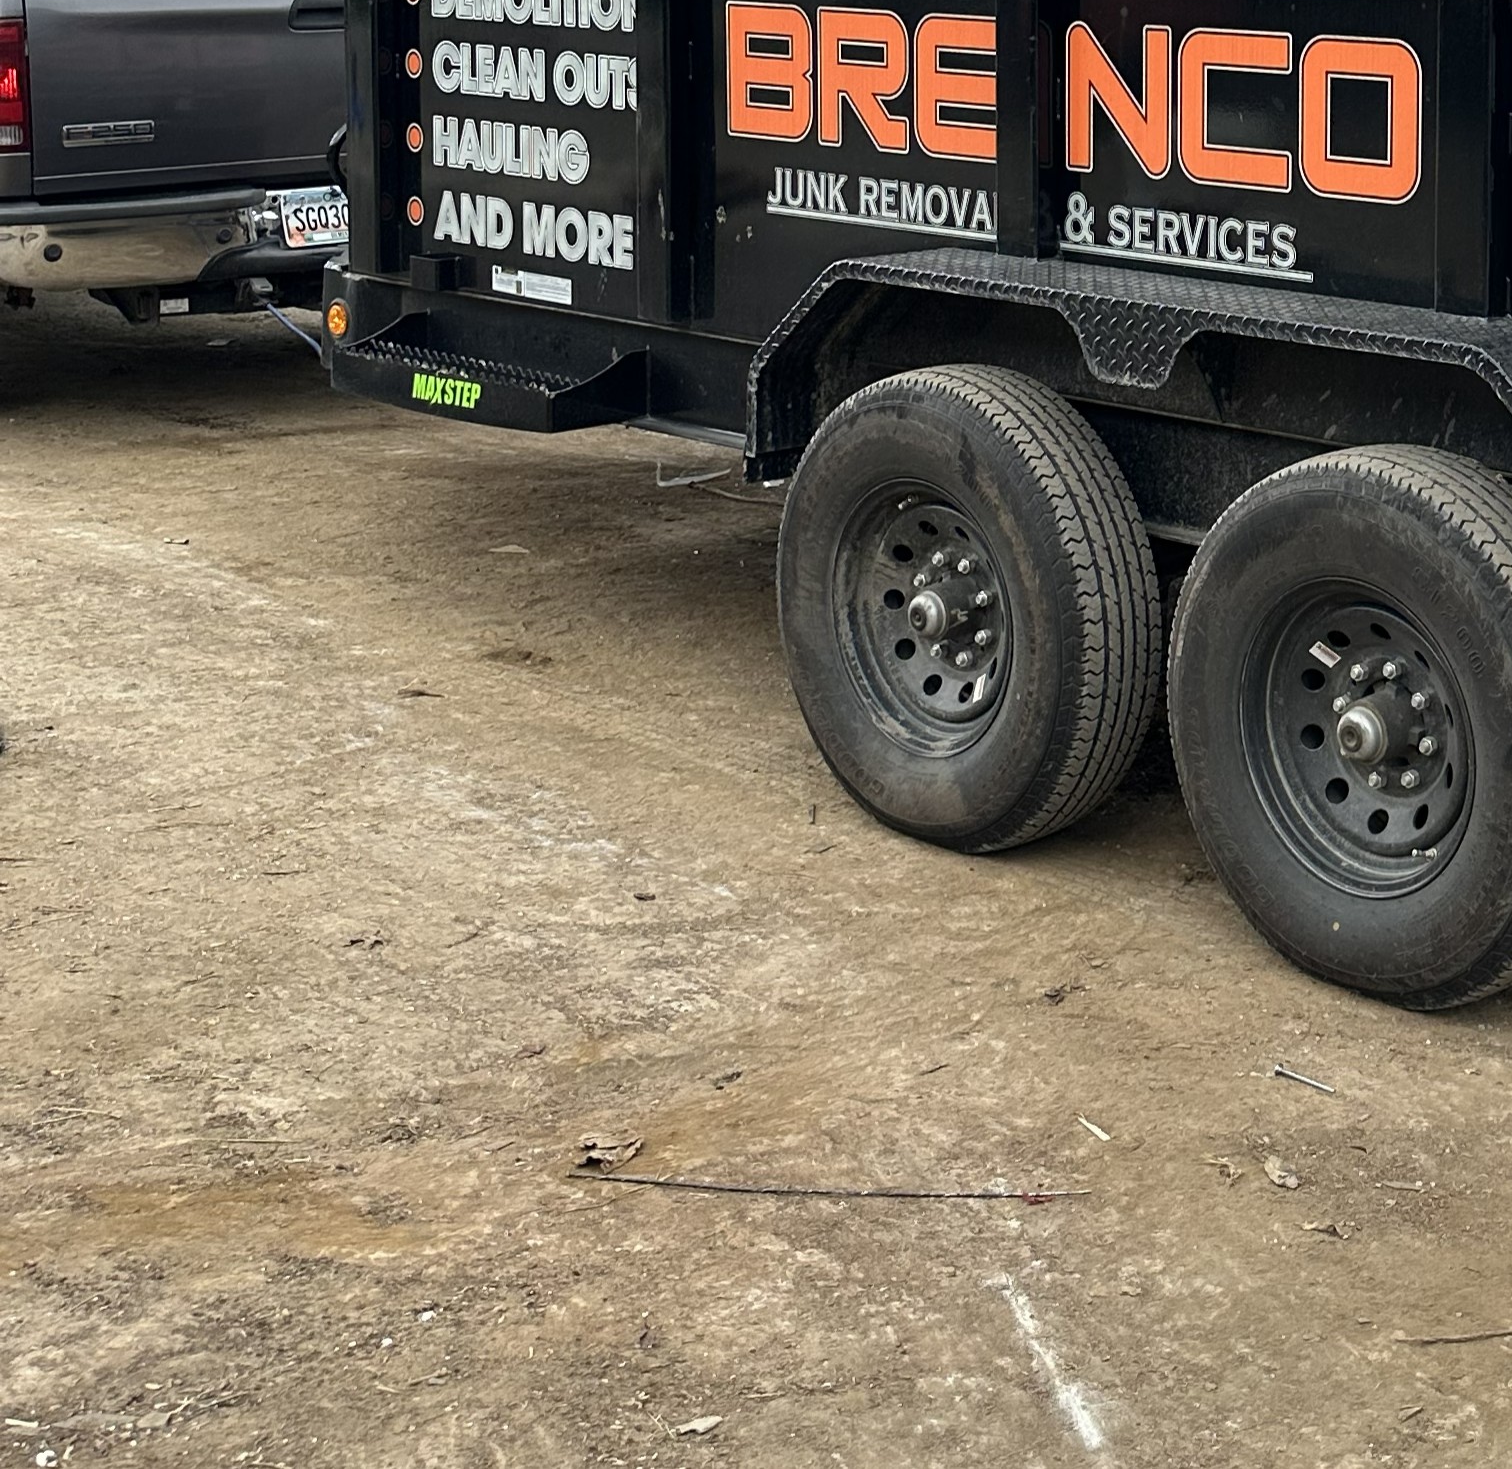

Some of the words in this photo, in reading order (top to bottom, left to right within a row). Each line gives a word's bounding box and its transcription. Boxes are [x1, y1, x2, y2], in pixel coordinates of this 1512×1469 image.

[432, 40, 545, 102] CLEAN
[726, 0, 1423, 205] BRENCO
[433, 115, 589, 185] HAULING
[433, 190, 514, 250] AND
[522, 201, 634, 270] MORE
[767, 167, 848, 214] JUNK
[858, 176, 998, 231] REMOVA
[1064, 191, 1094, 244] &
[1107, 204, 1297, 270] SERVICES
[411, 372, 482, 409] MAXSTEP
